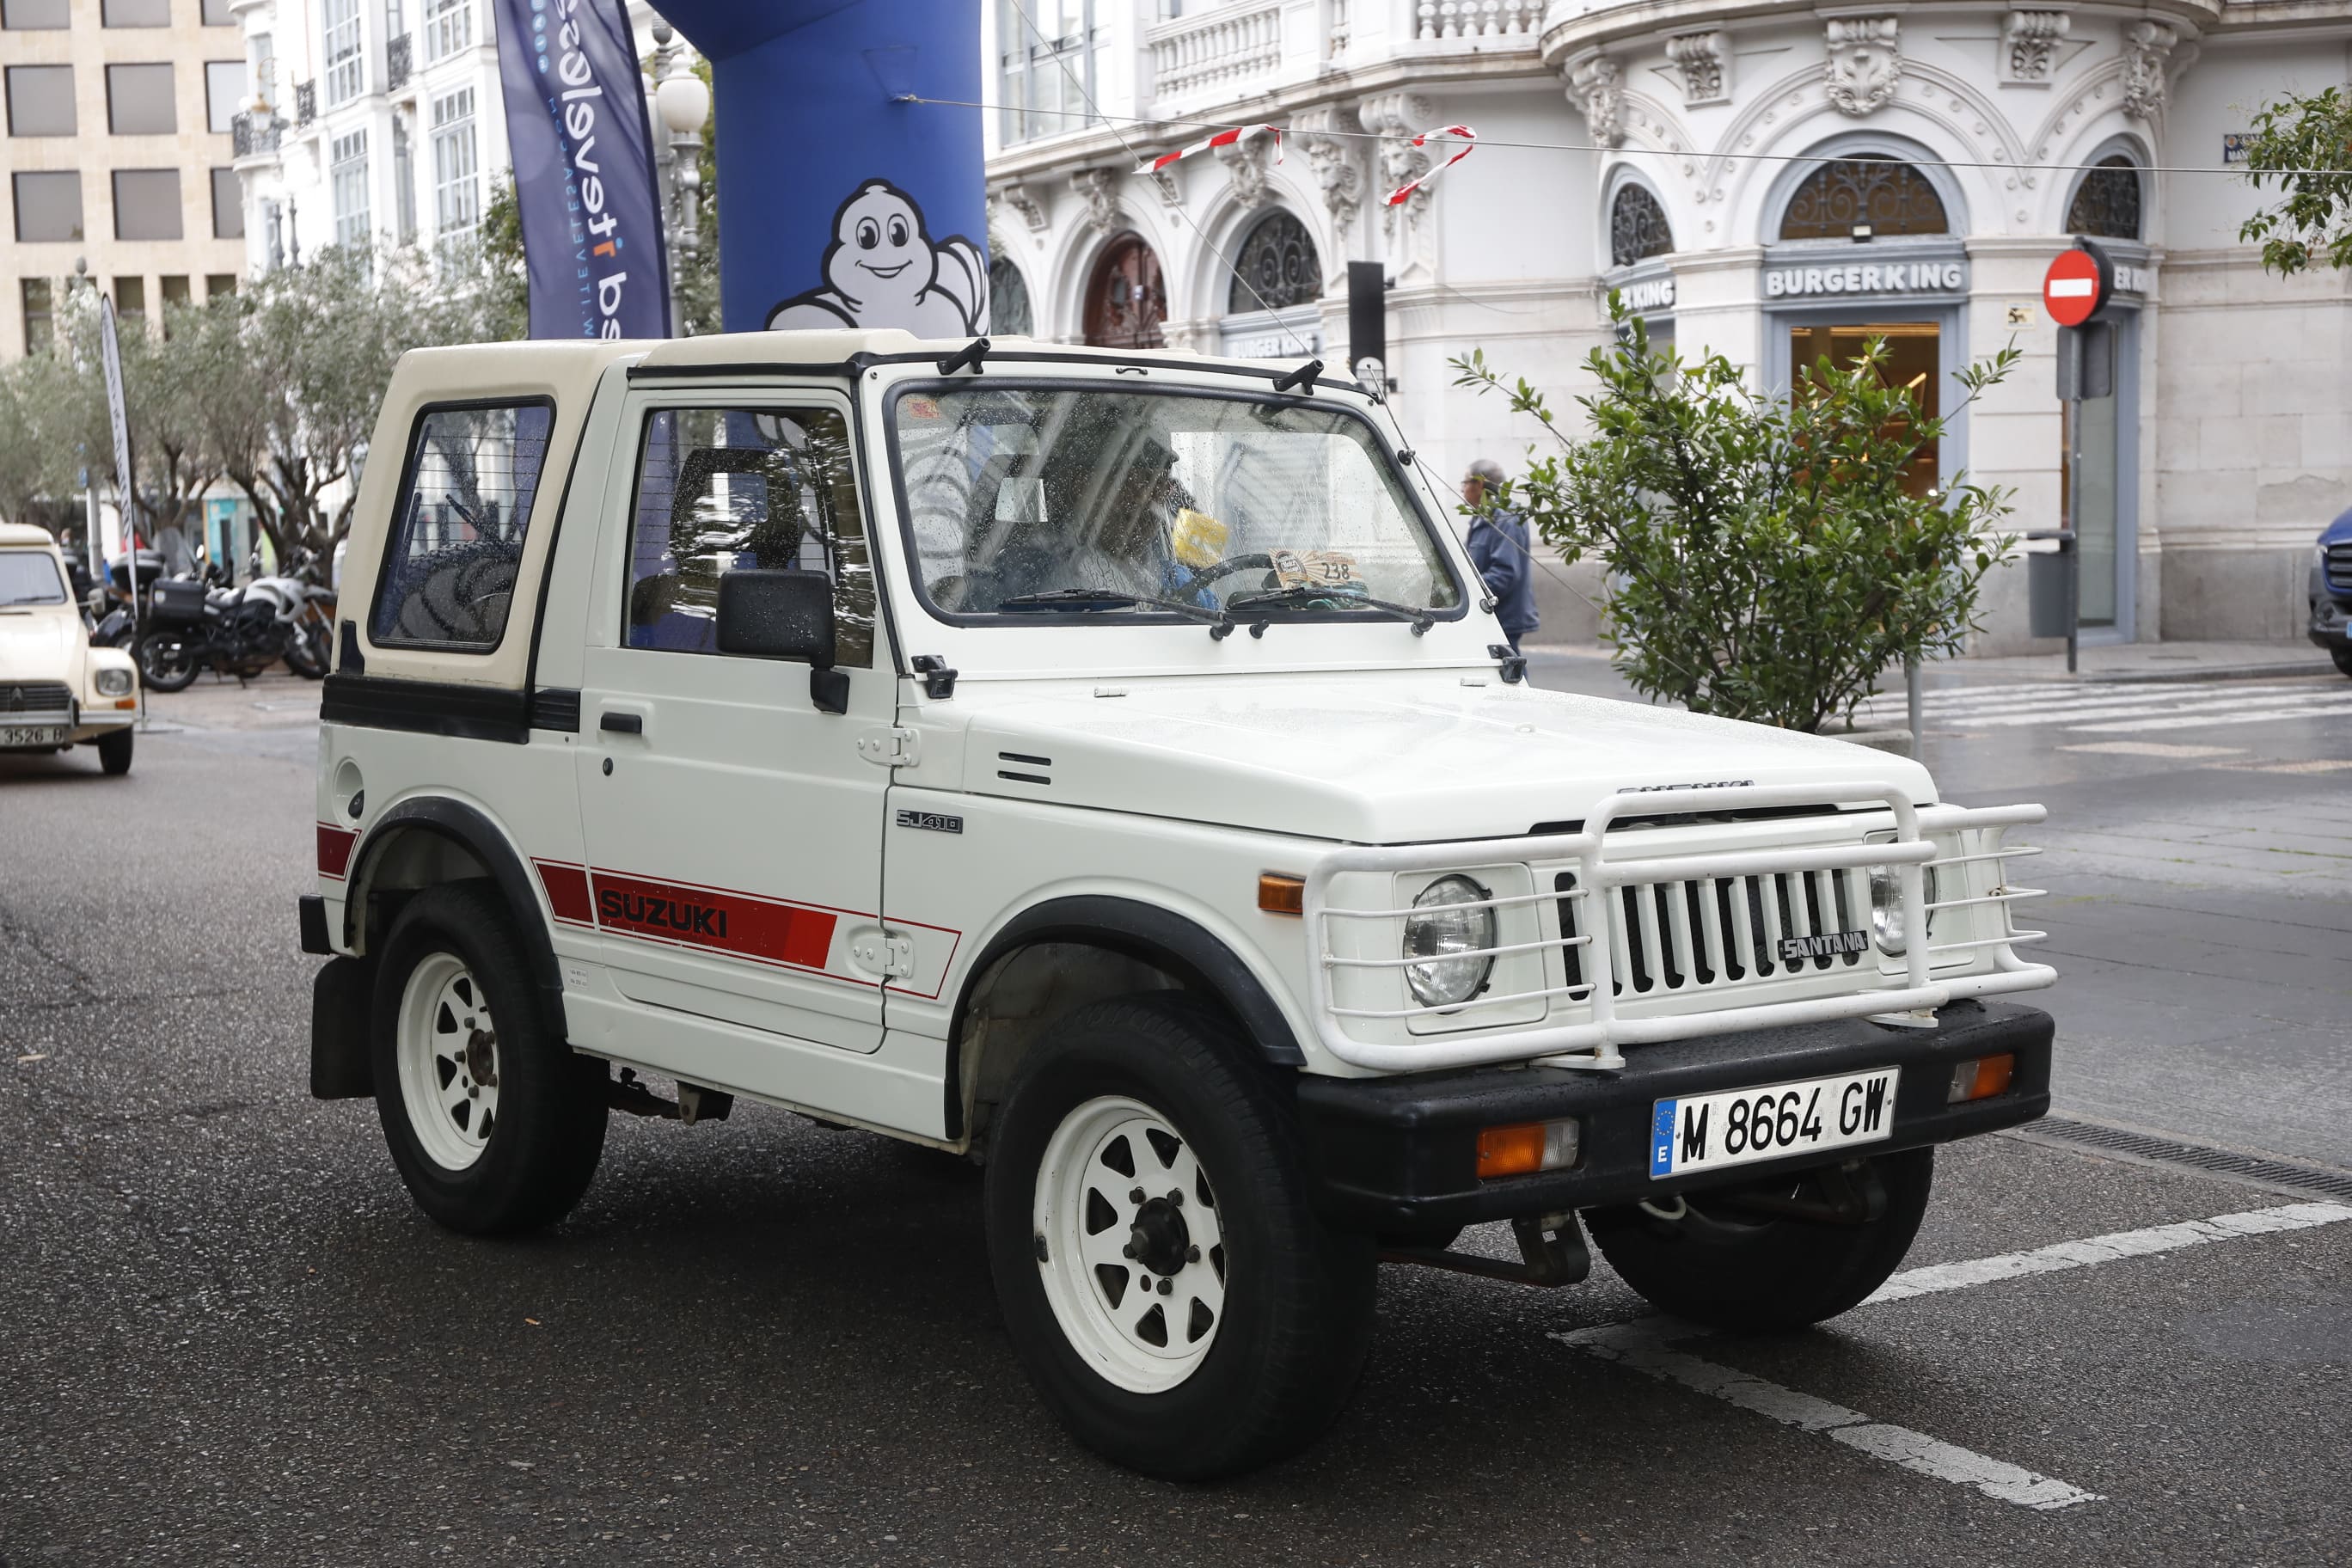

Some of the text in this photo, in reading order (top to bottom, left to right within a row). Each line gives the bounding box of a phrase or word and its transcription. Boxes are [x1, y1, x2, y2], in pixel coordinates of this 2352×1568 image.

[1767, 264, 1962, 296] BURGER KING
[1633, 280, 1674, 309] KING
[1321, 563, 1351, 579] 238
[4, 729, 44, 744] 3526
[897, 810, 962, 832] SJ410
[601, 890, 727, 939] SUZUKI
[1784, 932, 1866, 959] SANTANA
[1681, 1076, 1888, 1163] M 8664 GW
[1657, 1145, 1668, 1162] E
